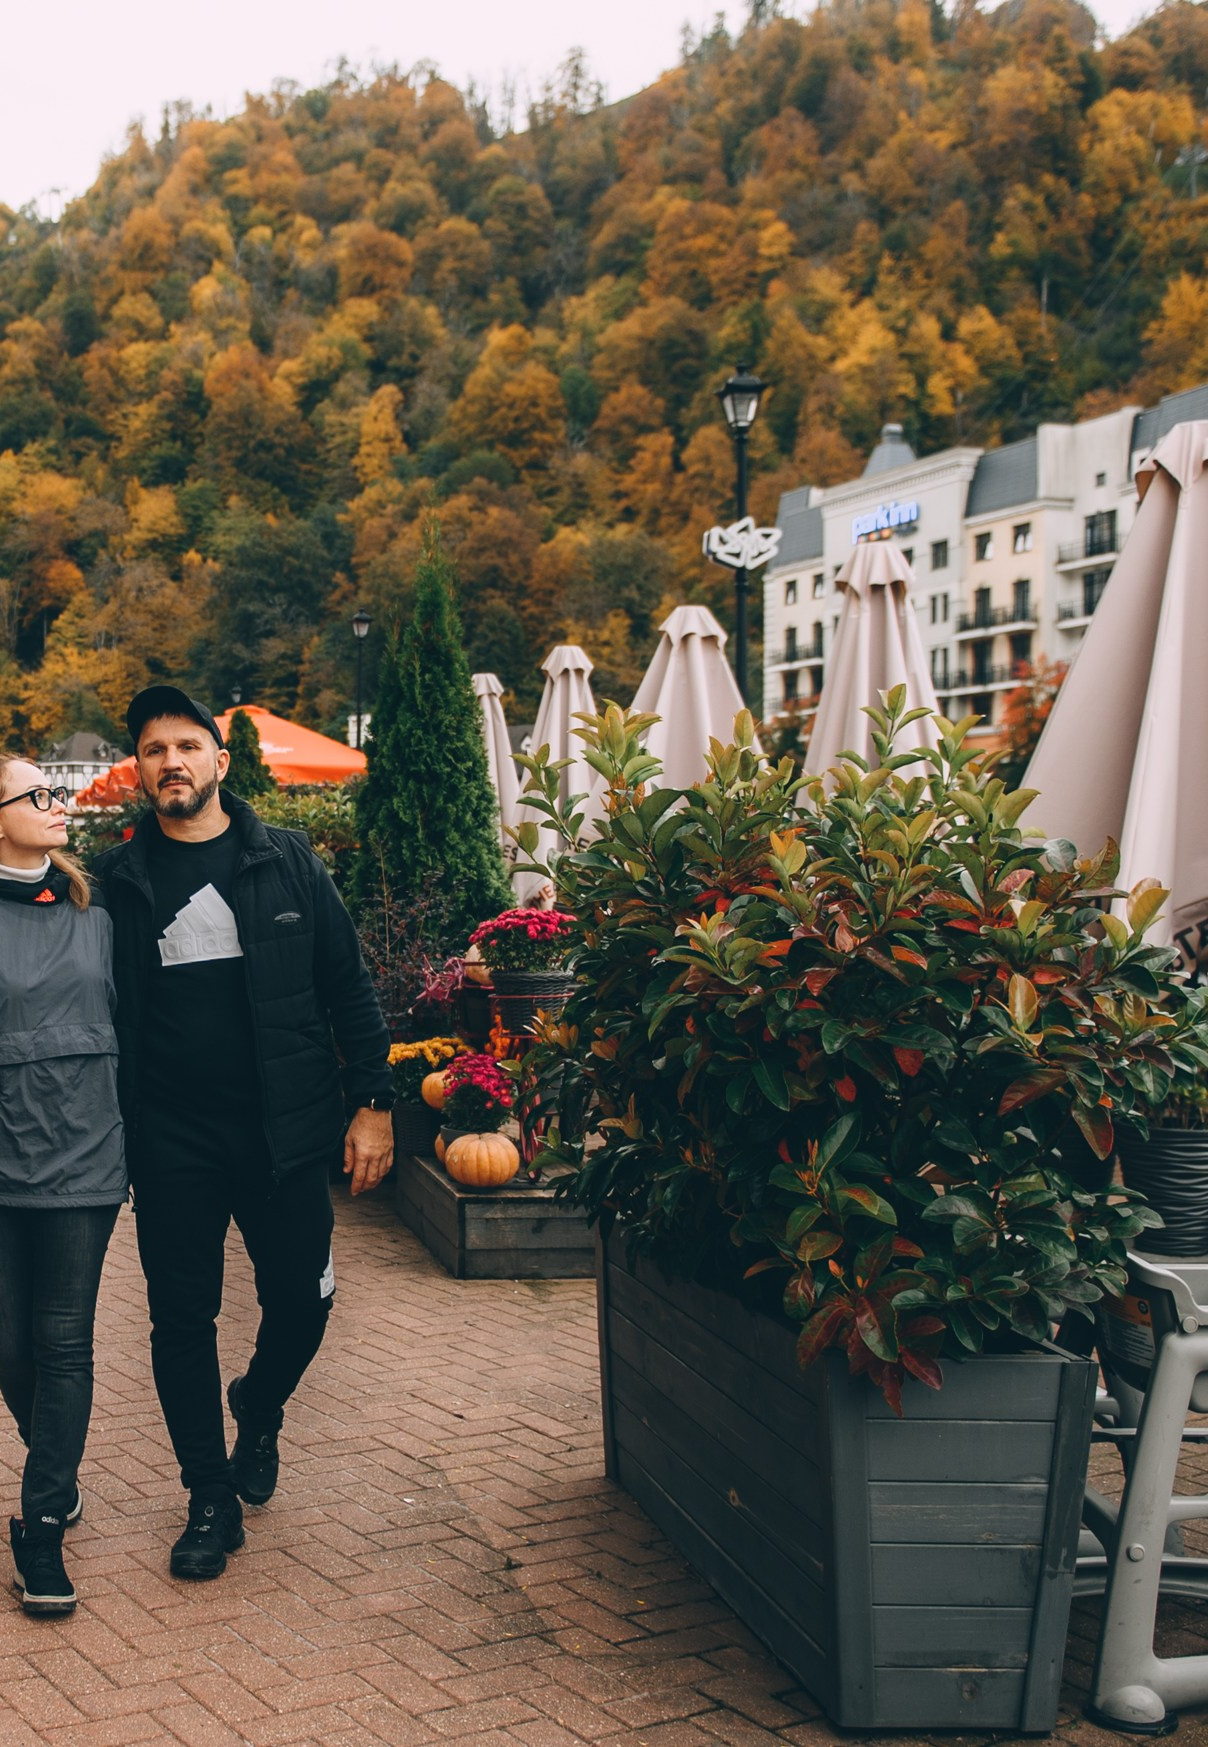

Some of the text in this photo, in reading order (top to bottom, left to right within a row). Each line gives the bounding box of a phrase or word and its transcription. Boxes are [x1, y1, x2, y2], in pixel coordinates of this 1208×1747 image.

[852, 505, 889, 544] park
[889, 501, 918, 527] inn
[164, 934, 239, 960] adida
